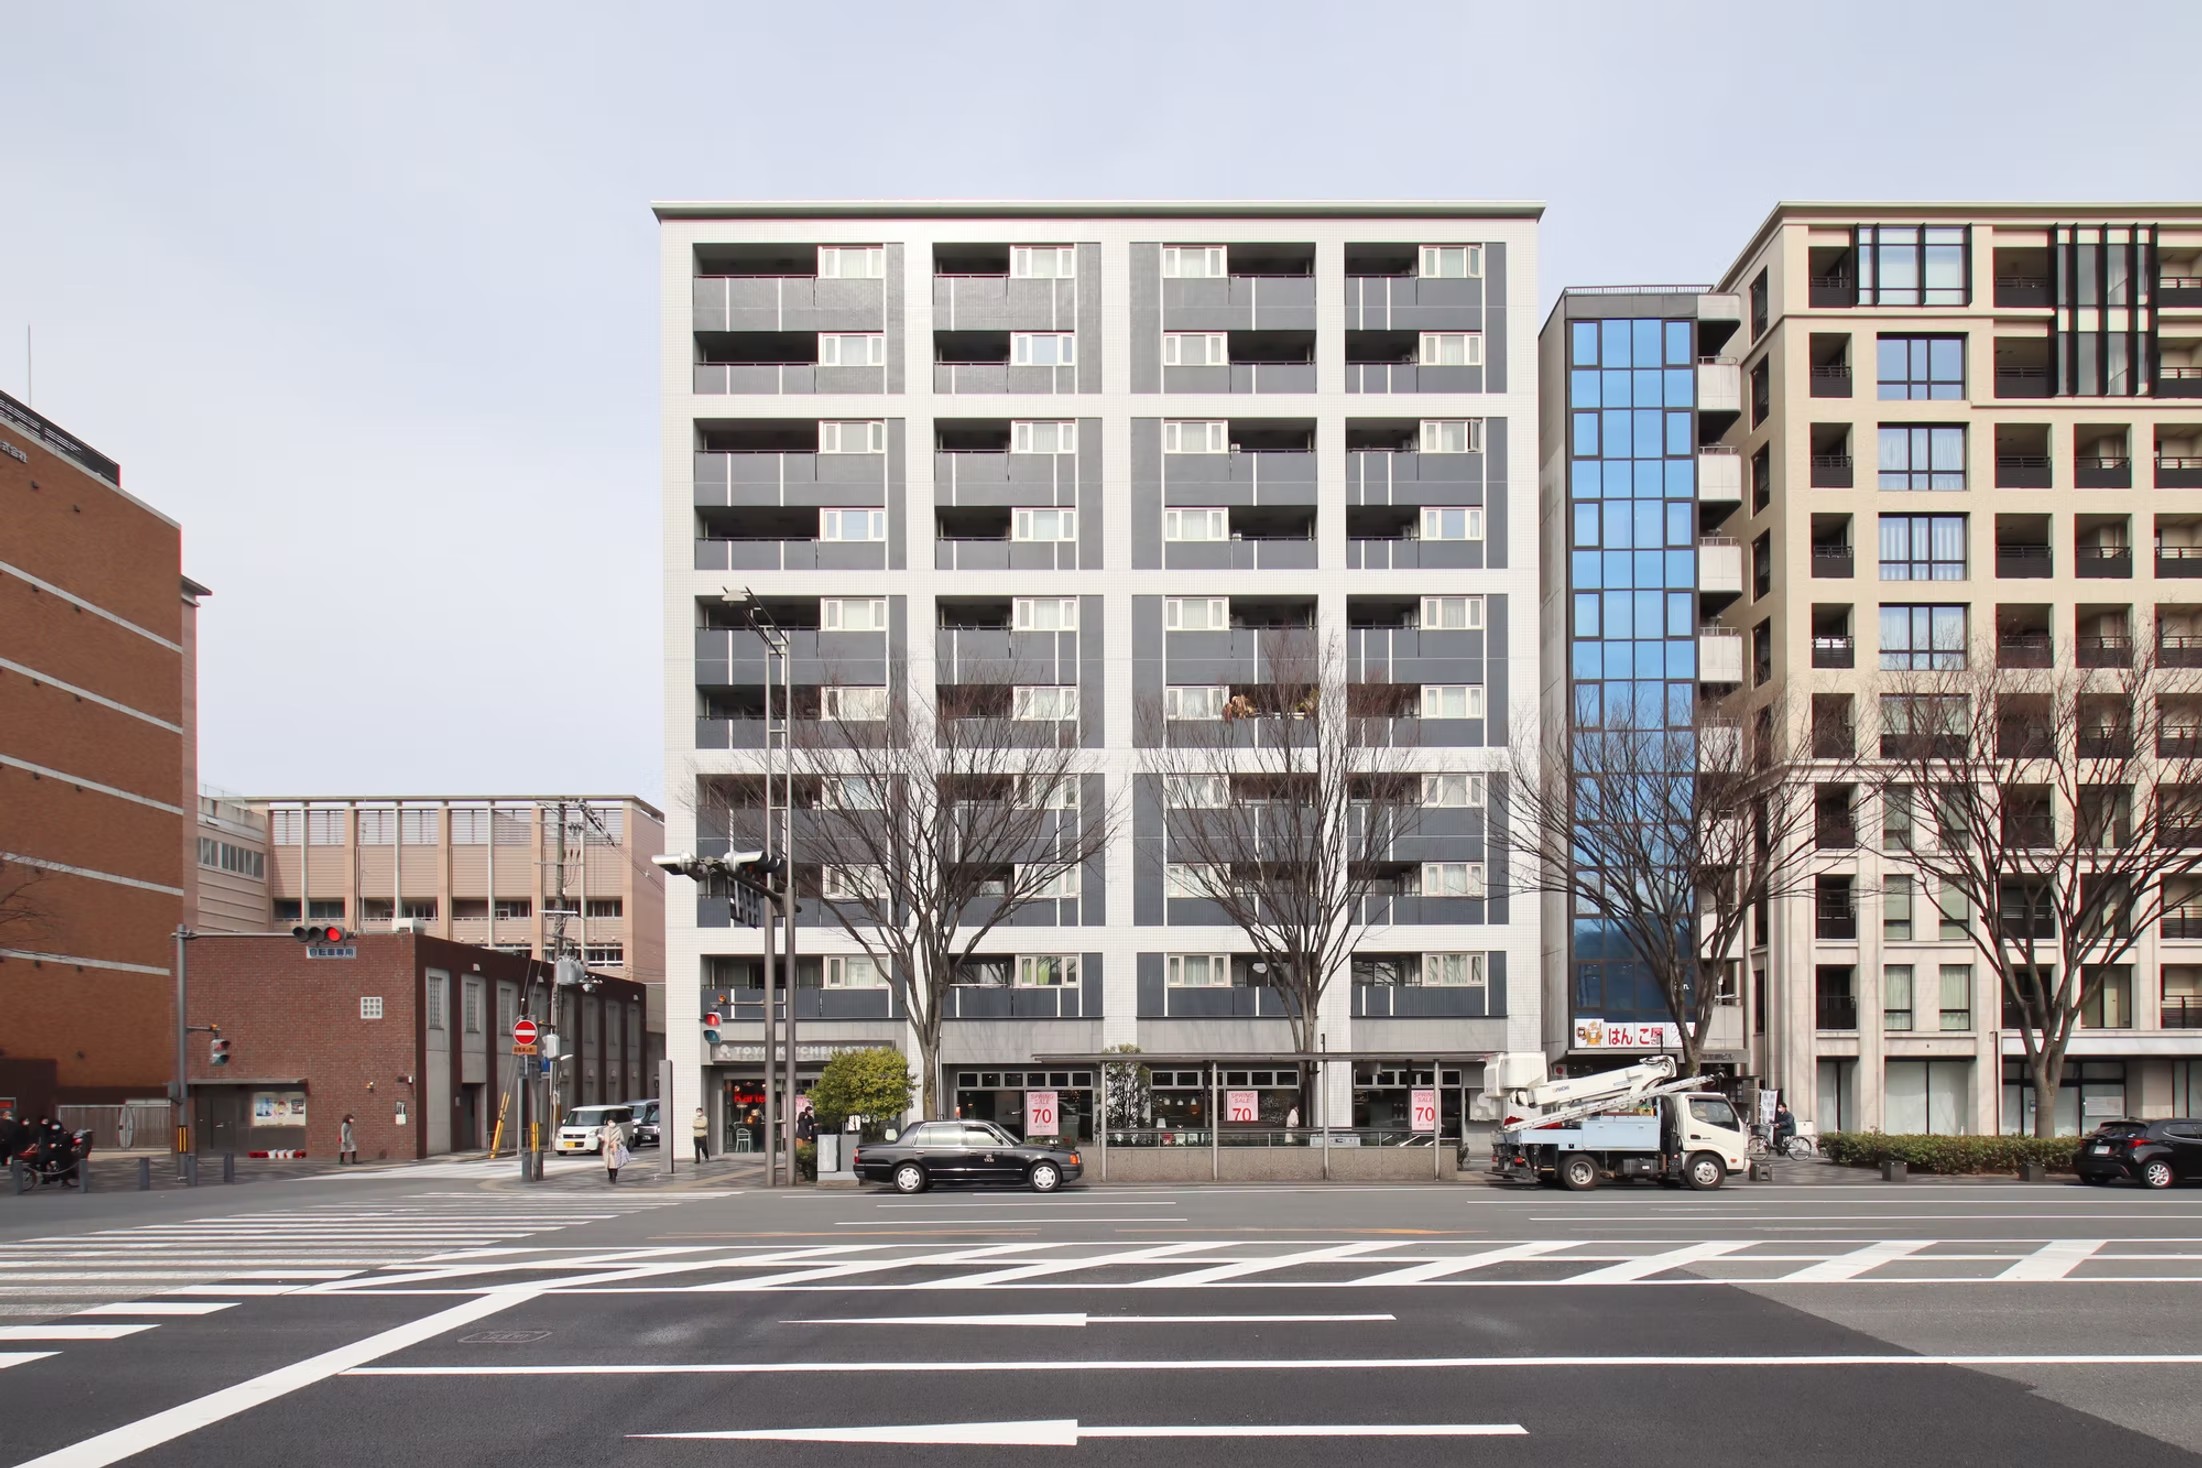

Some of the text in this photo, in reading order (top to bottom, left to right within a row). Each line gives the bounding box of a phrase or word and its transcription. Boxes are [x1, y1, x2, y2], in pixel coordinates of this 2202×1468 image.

[0, 440, 28, 463] 式会社
[775, 1046, 838, 1056] KCHEN
[1032, 1108, 1052, 1124] 70
[1232, 1107, 1252, 1121] 70
[1415, 1107, 1435, 1122] 70
